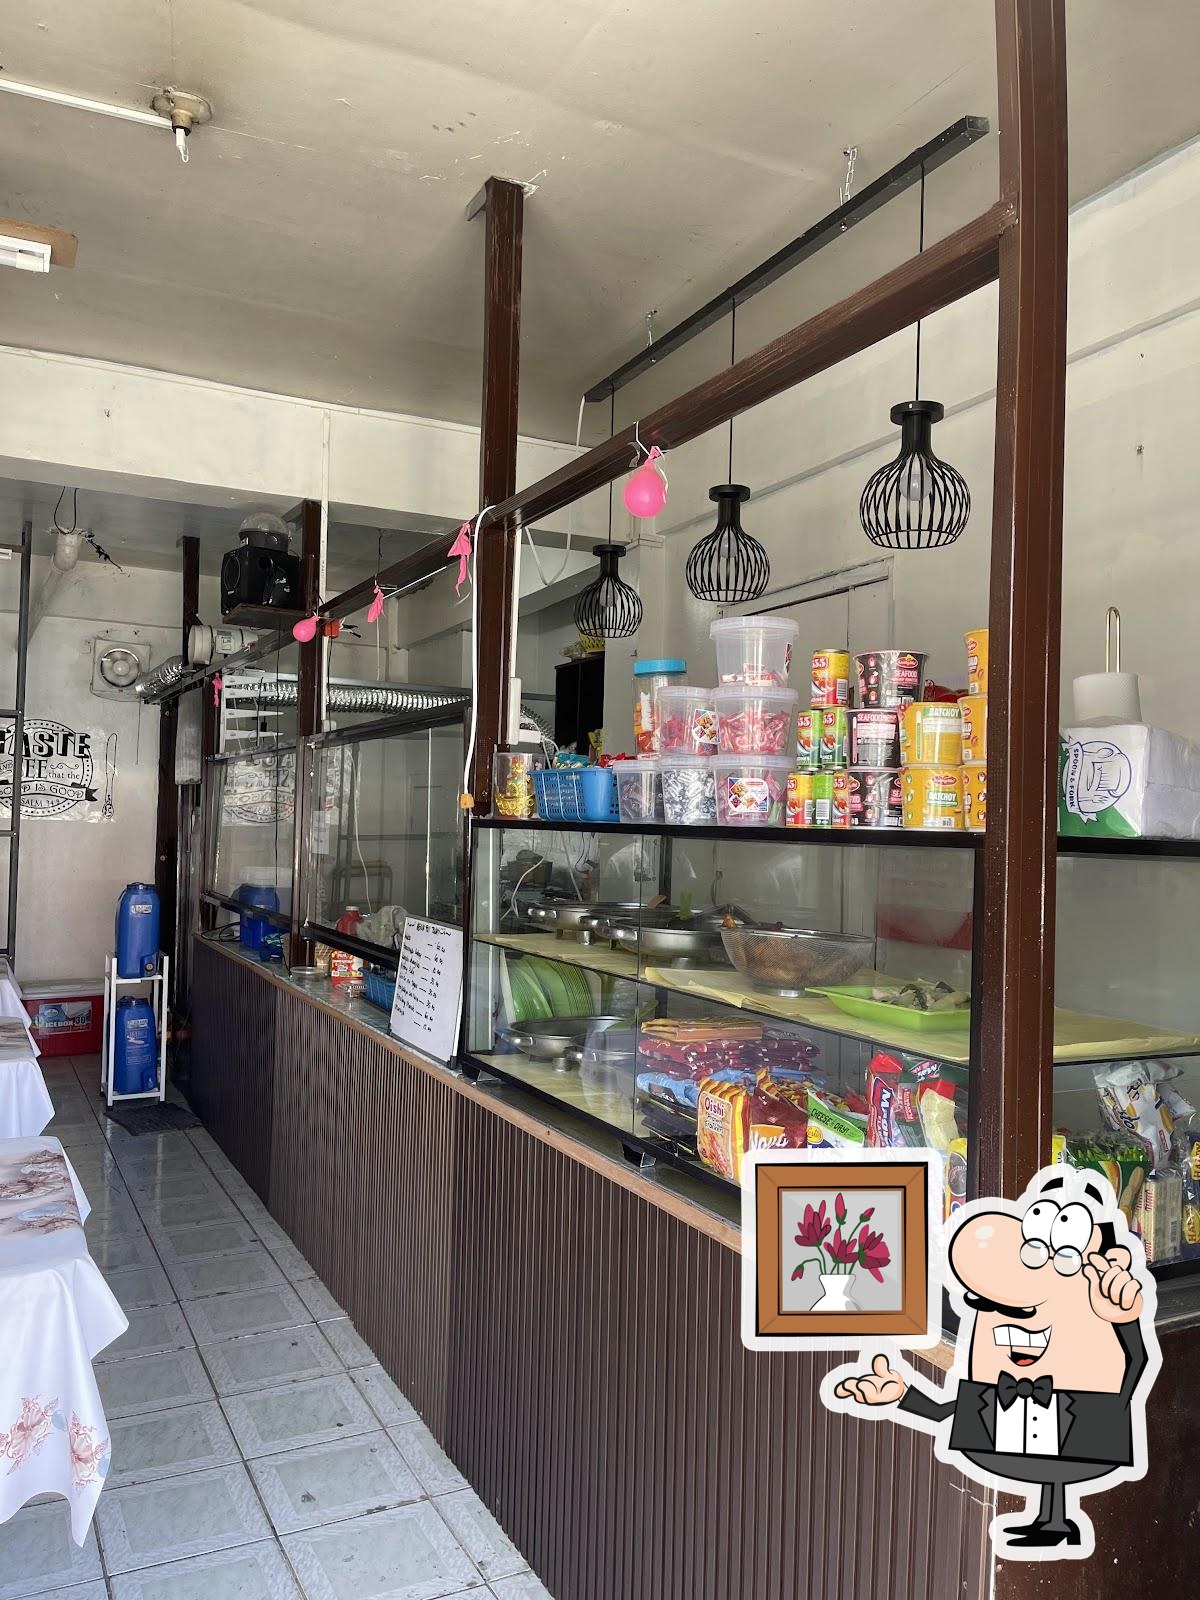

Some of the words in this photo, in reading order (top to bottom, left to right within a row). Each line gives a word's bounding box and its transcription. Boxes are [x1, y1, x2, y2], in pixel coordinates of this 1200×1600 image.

[894, 670, 918, 678] SEAFOOD
[928, 707, 960, 717] BATCHOY
[0, 729, 91, 758] ASTE
[22, 759, 48, 779] EE
[1070, 748, 1080, 776] SPOON
[48, 771, 65, 779] that
[67, 771, 80, 779] the
[35, 783, 46, 792] IS
[50, 784, 84, 799] GOOD
[928, 791, 956, 801] BATCHOY
[1068, 785, 1076, 808] FORK
[20, 799, 43, 808] SALM
[704, 1096, 725, 1117] Oishi
[810, 1108, 833, 1126] CHEESE
[751, 1130, 789, 1150] Nova
